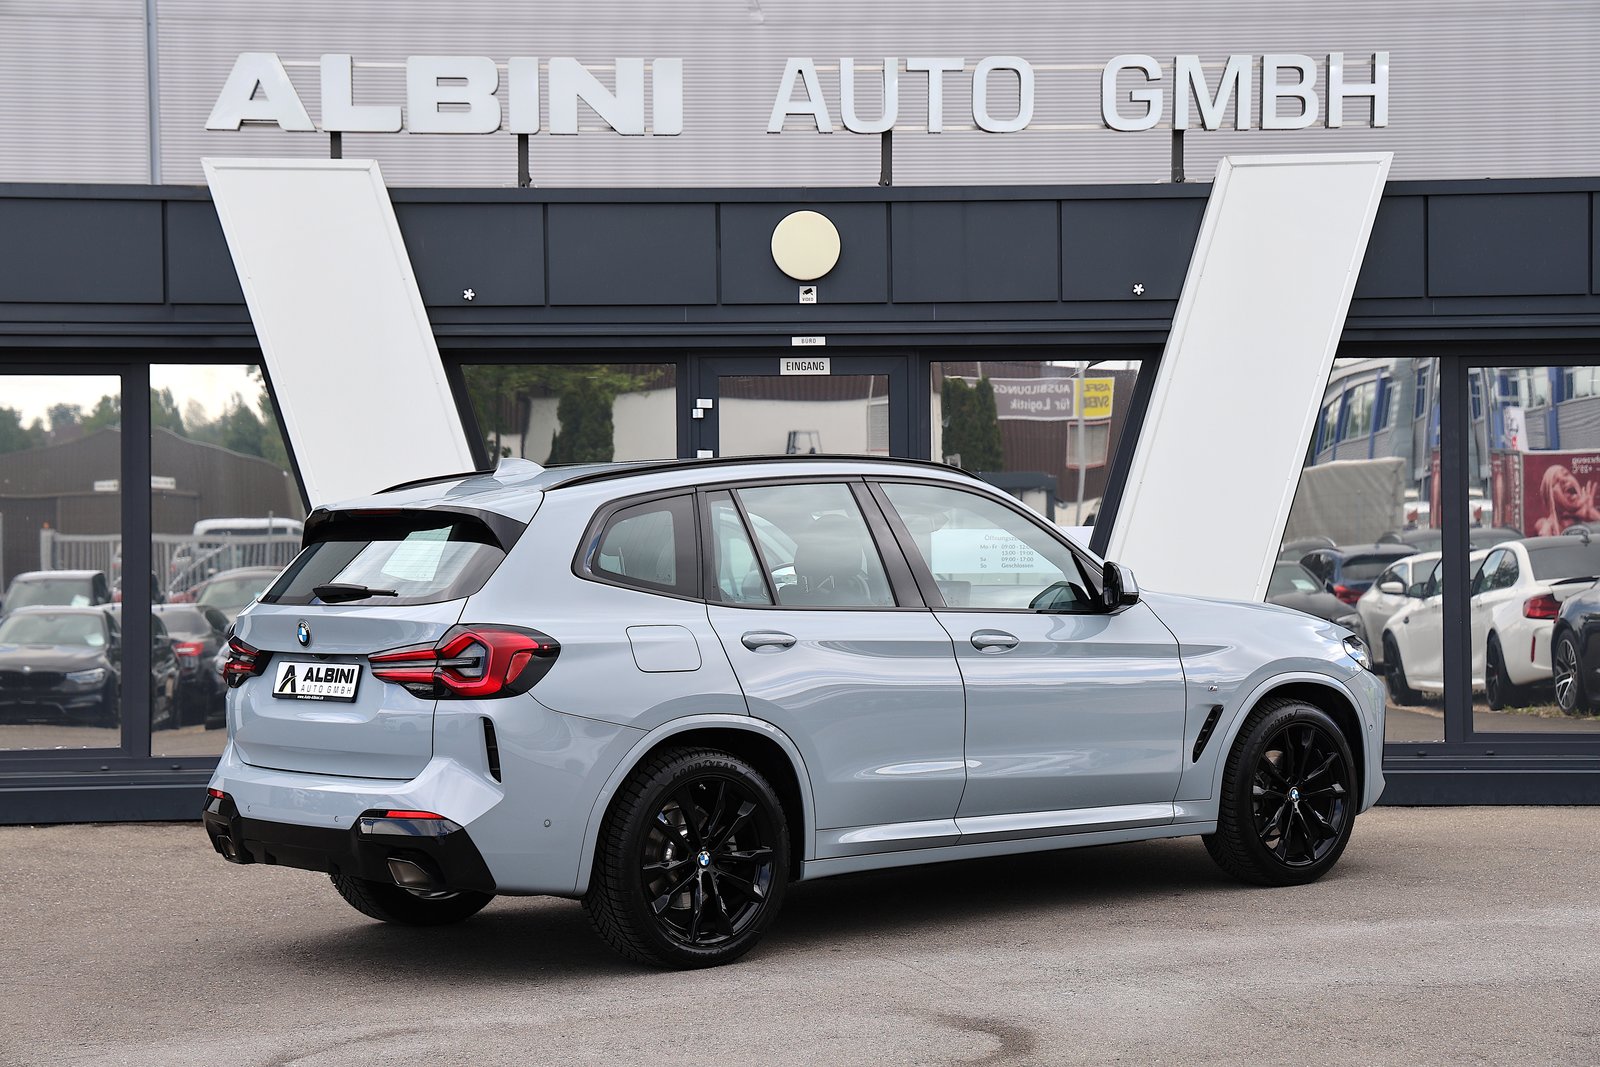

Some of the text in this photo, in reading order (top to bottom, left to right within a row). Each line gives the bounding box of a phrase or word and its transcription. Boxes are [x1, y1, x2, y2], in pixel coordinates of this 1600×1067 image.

[205, 51, 1390, 136] ALBINI AUTO GMBH
[786, 361, 825, 371] EINGANG
[303, 667, 355, 684] ALBINI
[300, 684, 352, 694] AUTO GMBH
